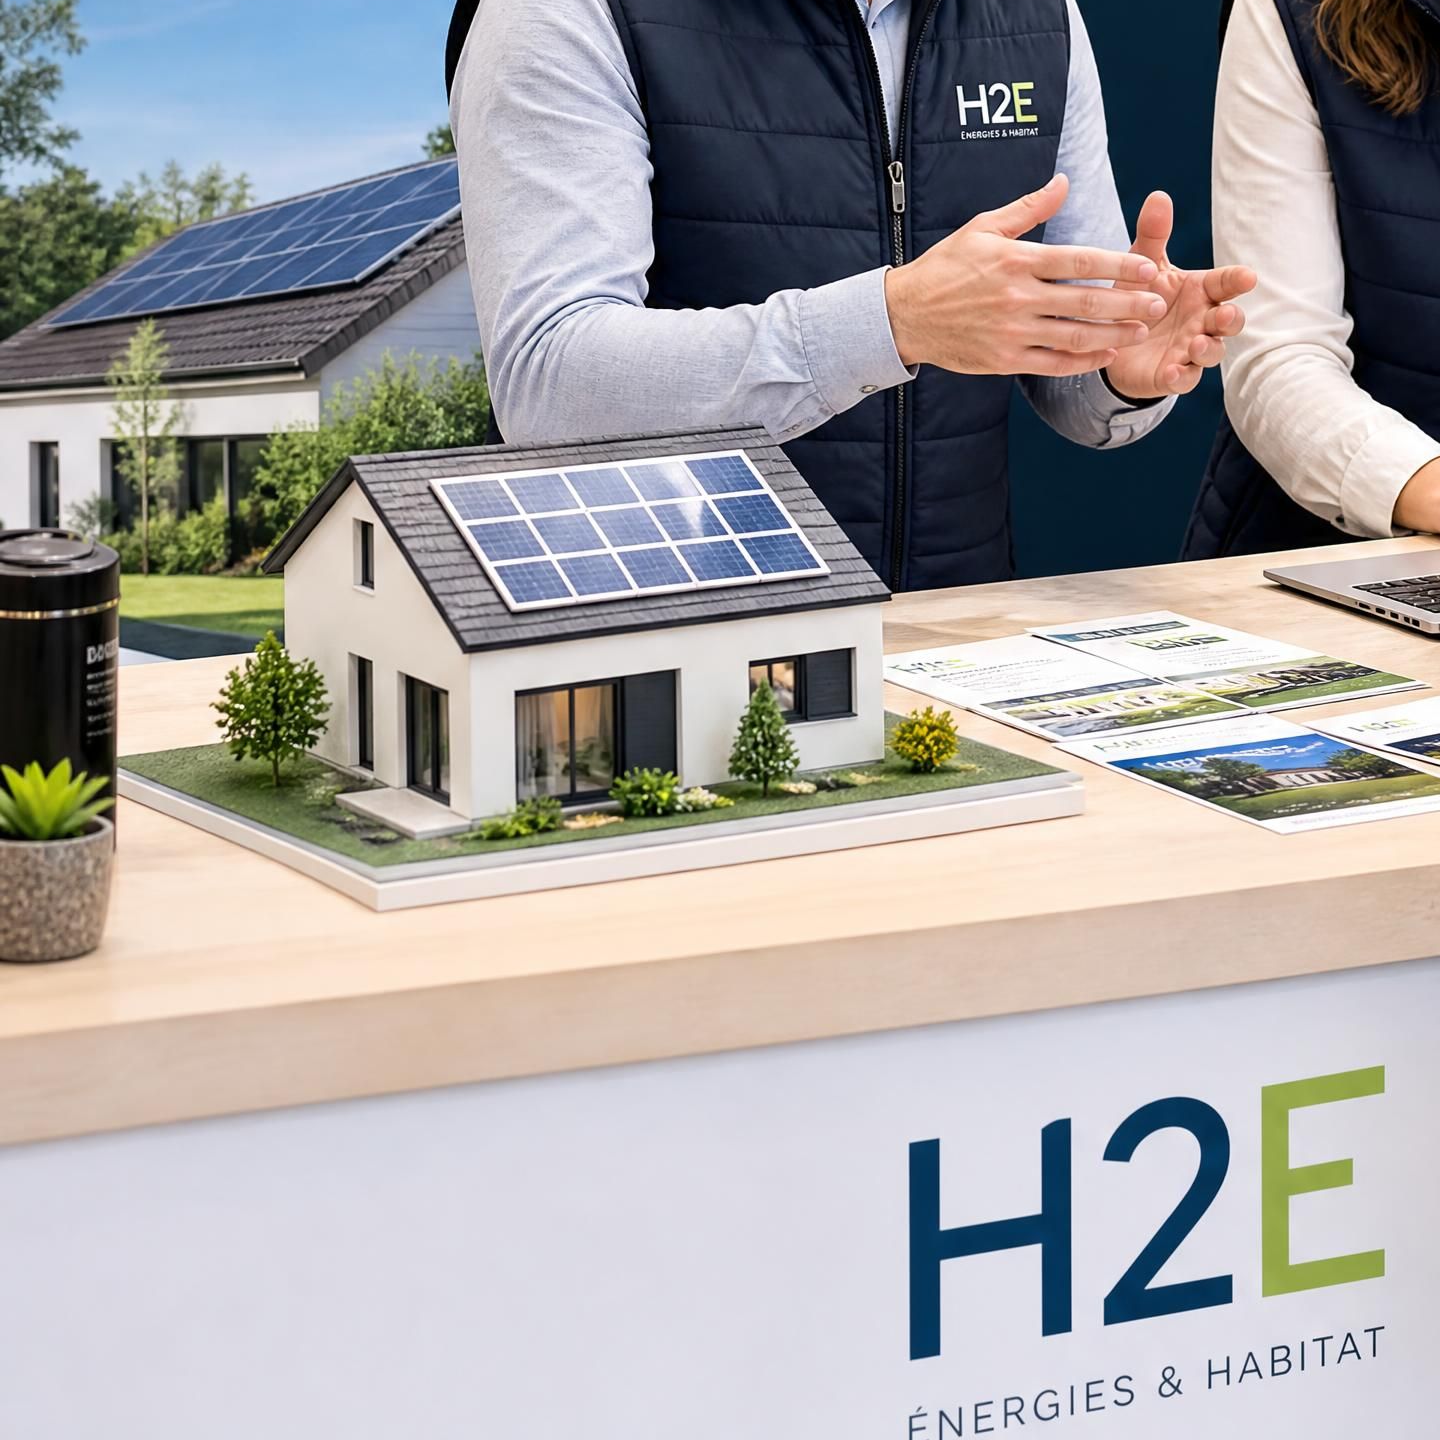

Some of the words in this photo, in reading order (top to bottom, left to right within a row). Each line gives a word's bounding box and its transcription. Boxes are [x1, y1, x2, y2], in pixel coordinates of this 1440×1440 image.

[955, 81, 1038, 126] H2E
[909, 1065, 1386, 1361] H2E
[907, 1374, 1135, 1440] ÉNERGIES
[1157, 1365, 1184, 1399] &
[1206, 1325, 1386, 1390] HABITAT
